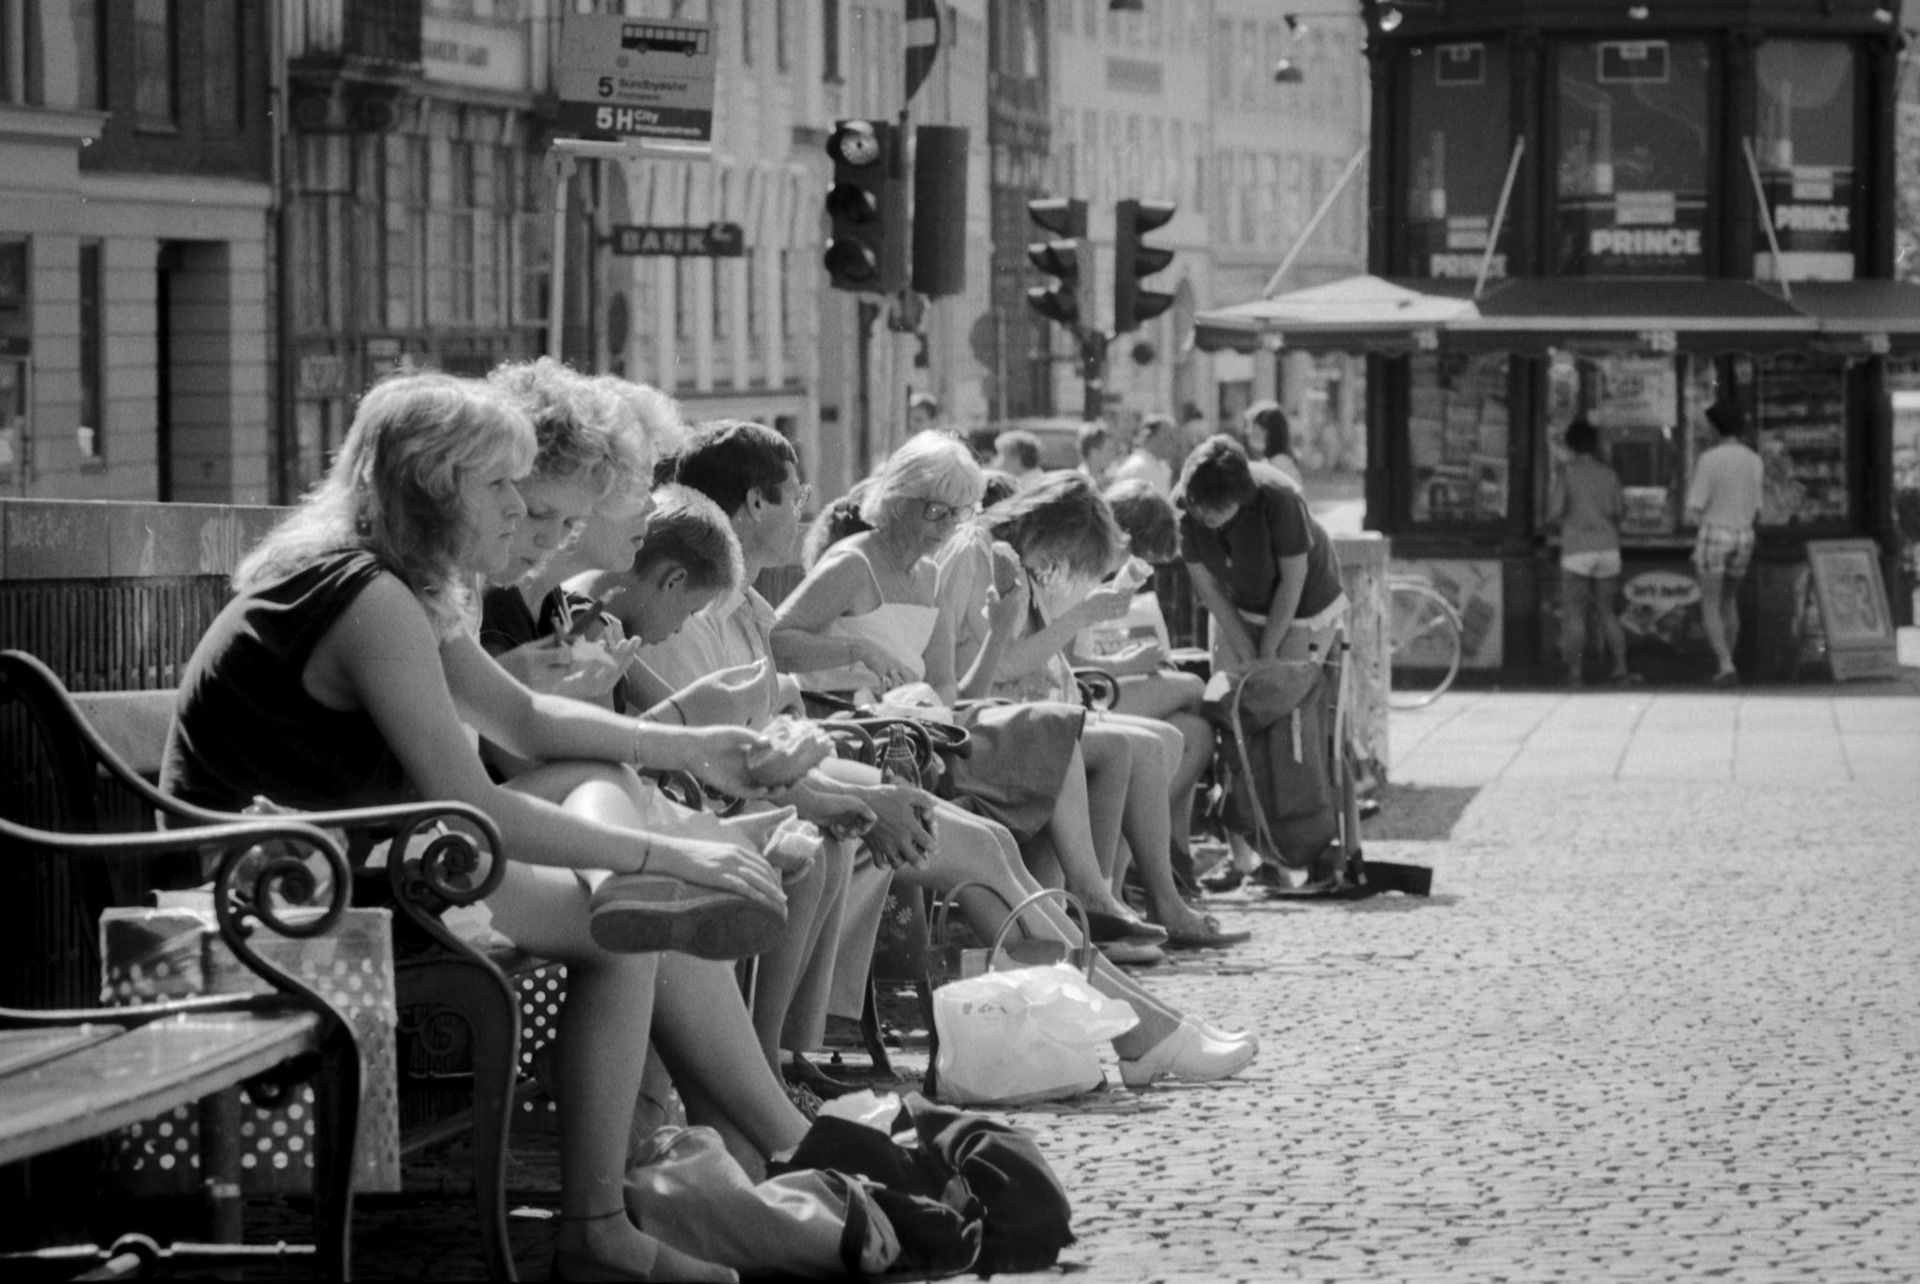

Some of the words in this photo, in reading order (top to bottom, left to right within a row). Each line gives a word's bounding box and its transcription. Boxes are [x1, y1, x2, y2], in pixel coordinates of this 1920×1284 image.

[598, 77, 614, 98] 5
[1774, 205, 1849, 231] PRINCE
[621, 230, 706, 252] BANK
[1591, 229, 1701, 255] PRINCE
